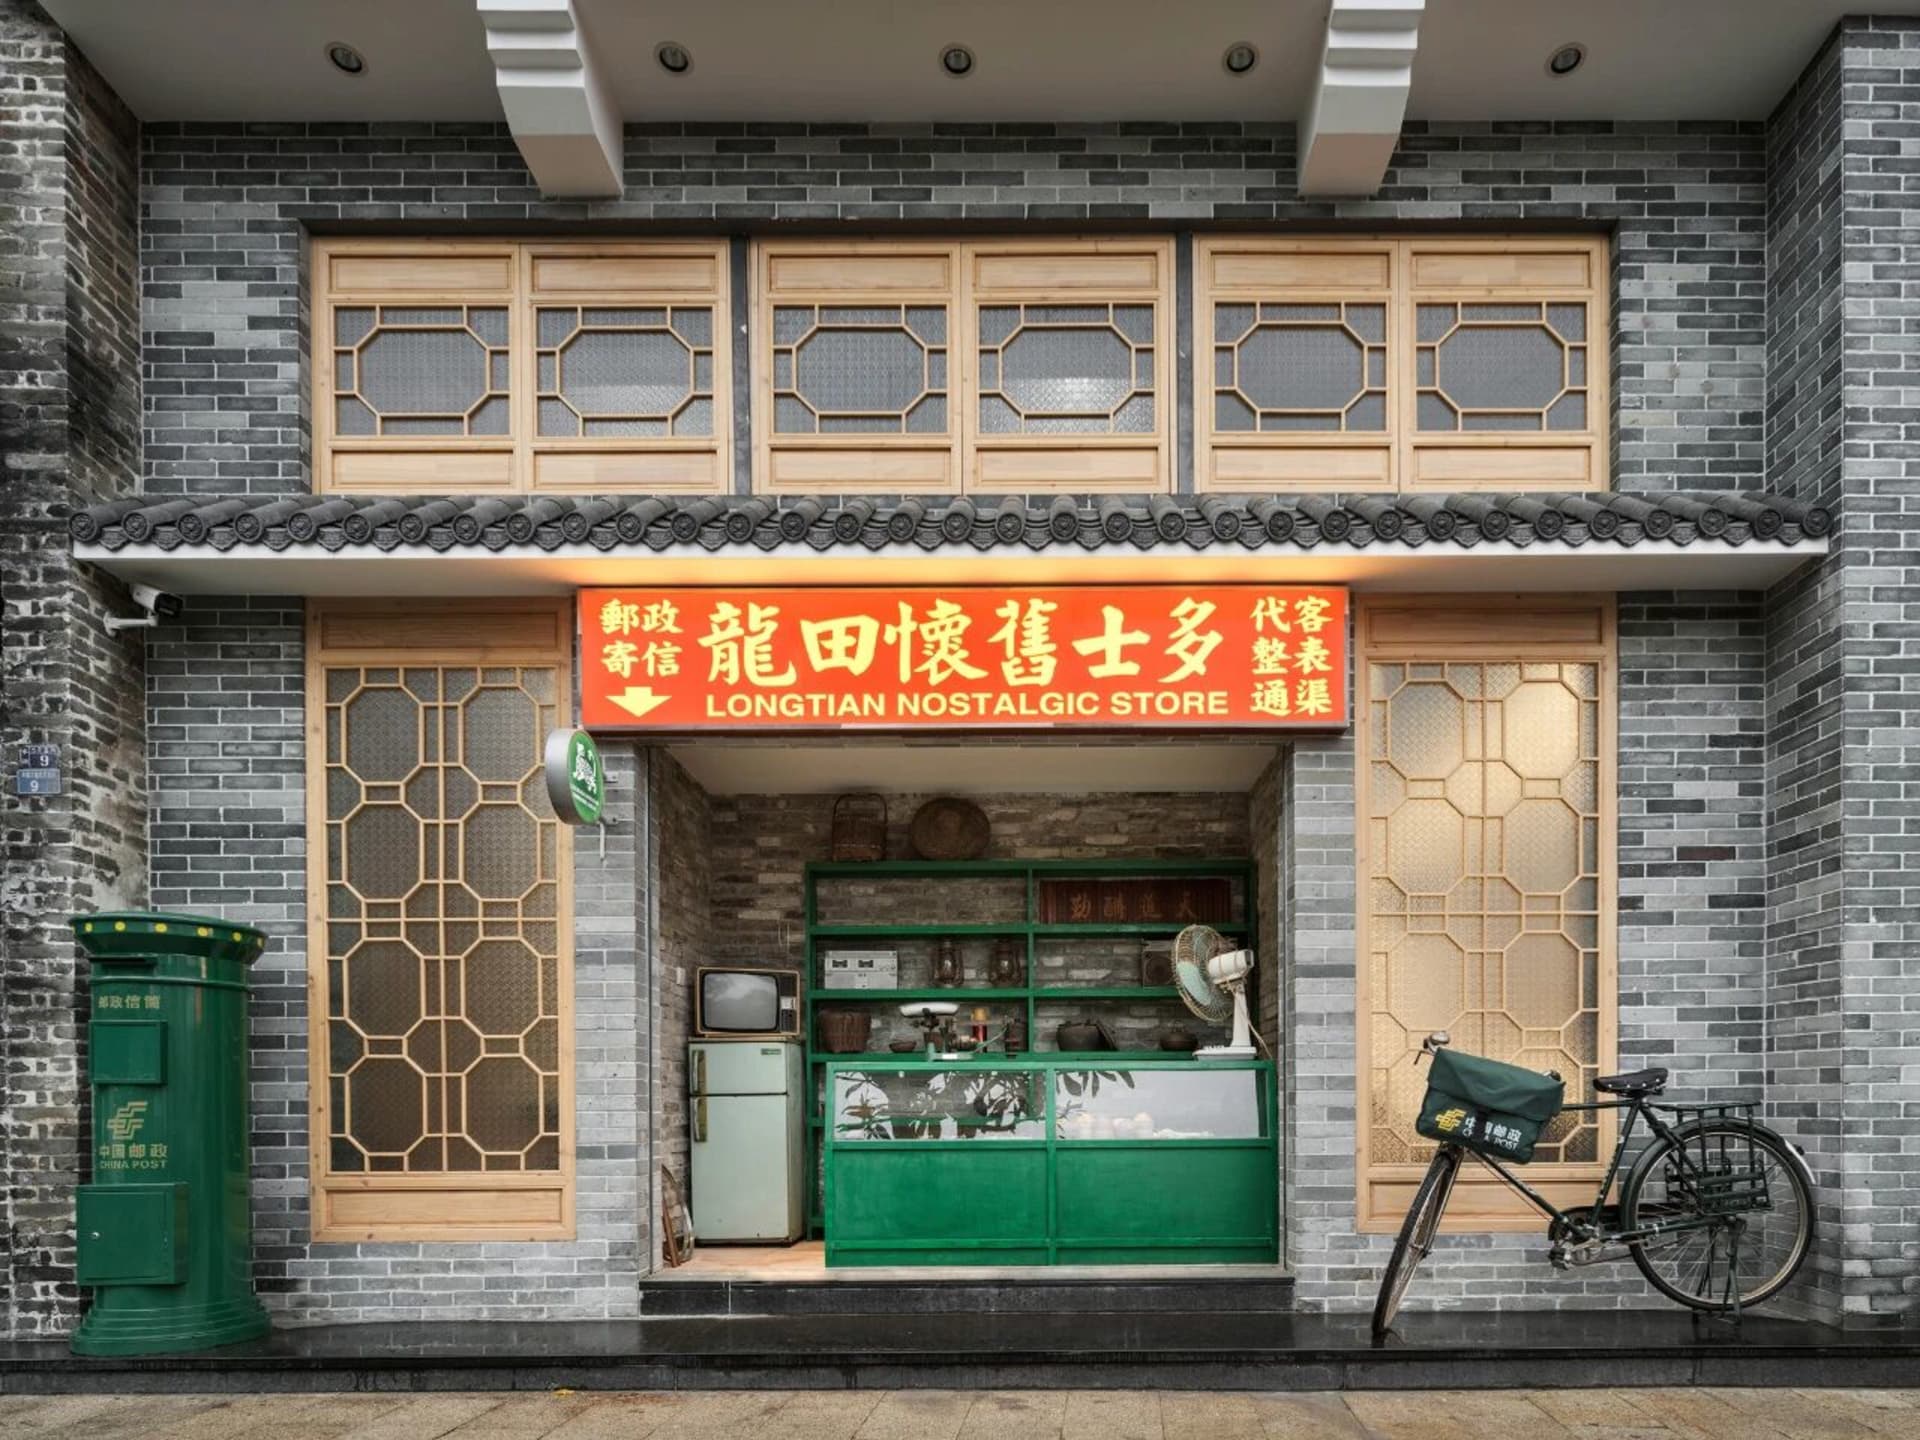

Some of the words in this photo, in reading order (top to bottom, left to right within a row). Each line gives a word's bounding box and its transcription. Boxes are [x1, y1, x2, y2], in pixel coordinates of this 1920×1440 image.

[600, 598, 683, 635] 郵政
[1250, 596, 1333, 633] 代客
[601, 640, 683, 678] 寄信
[698, 597, 1224, 687] 龍田懷舊士多
[1251, 636, 1333, 674] 整表
[706, 693, 885, 717] LONGTIAN
[897, 691, 1100, 716] NOSTALGIC
[1110, 690, 1229, 715] STORE
[1250, 677, 1333, 716] 通渠
[40, 755, 49, 766] 9
[30, 780, 39, 791] 9
[99, 1143, 168, 1159] 中国邮政
[100, 1160, 129, 1169] CHINA
[132, 1160, 167, 1169] POST
